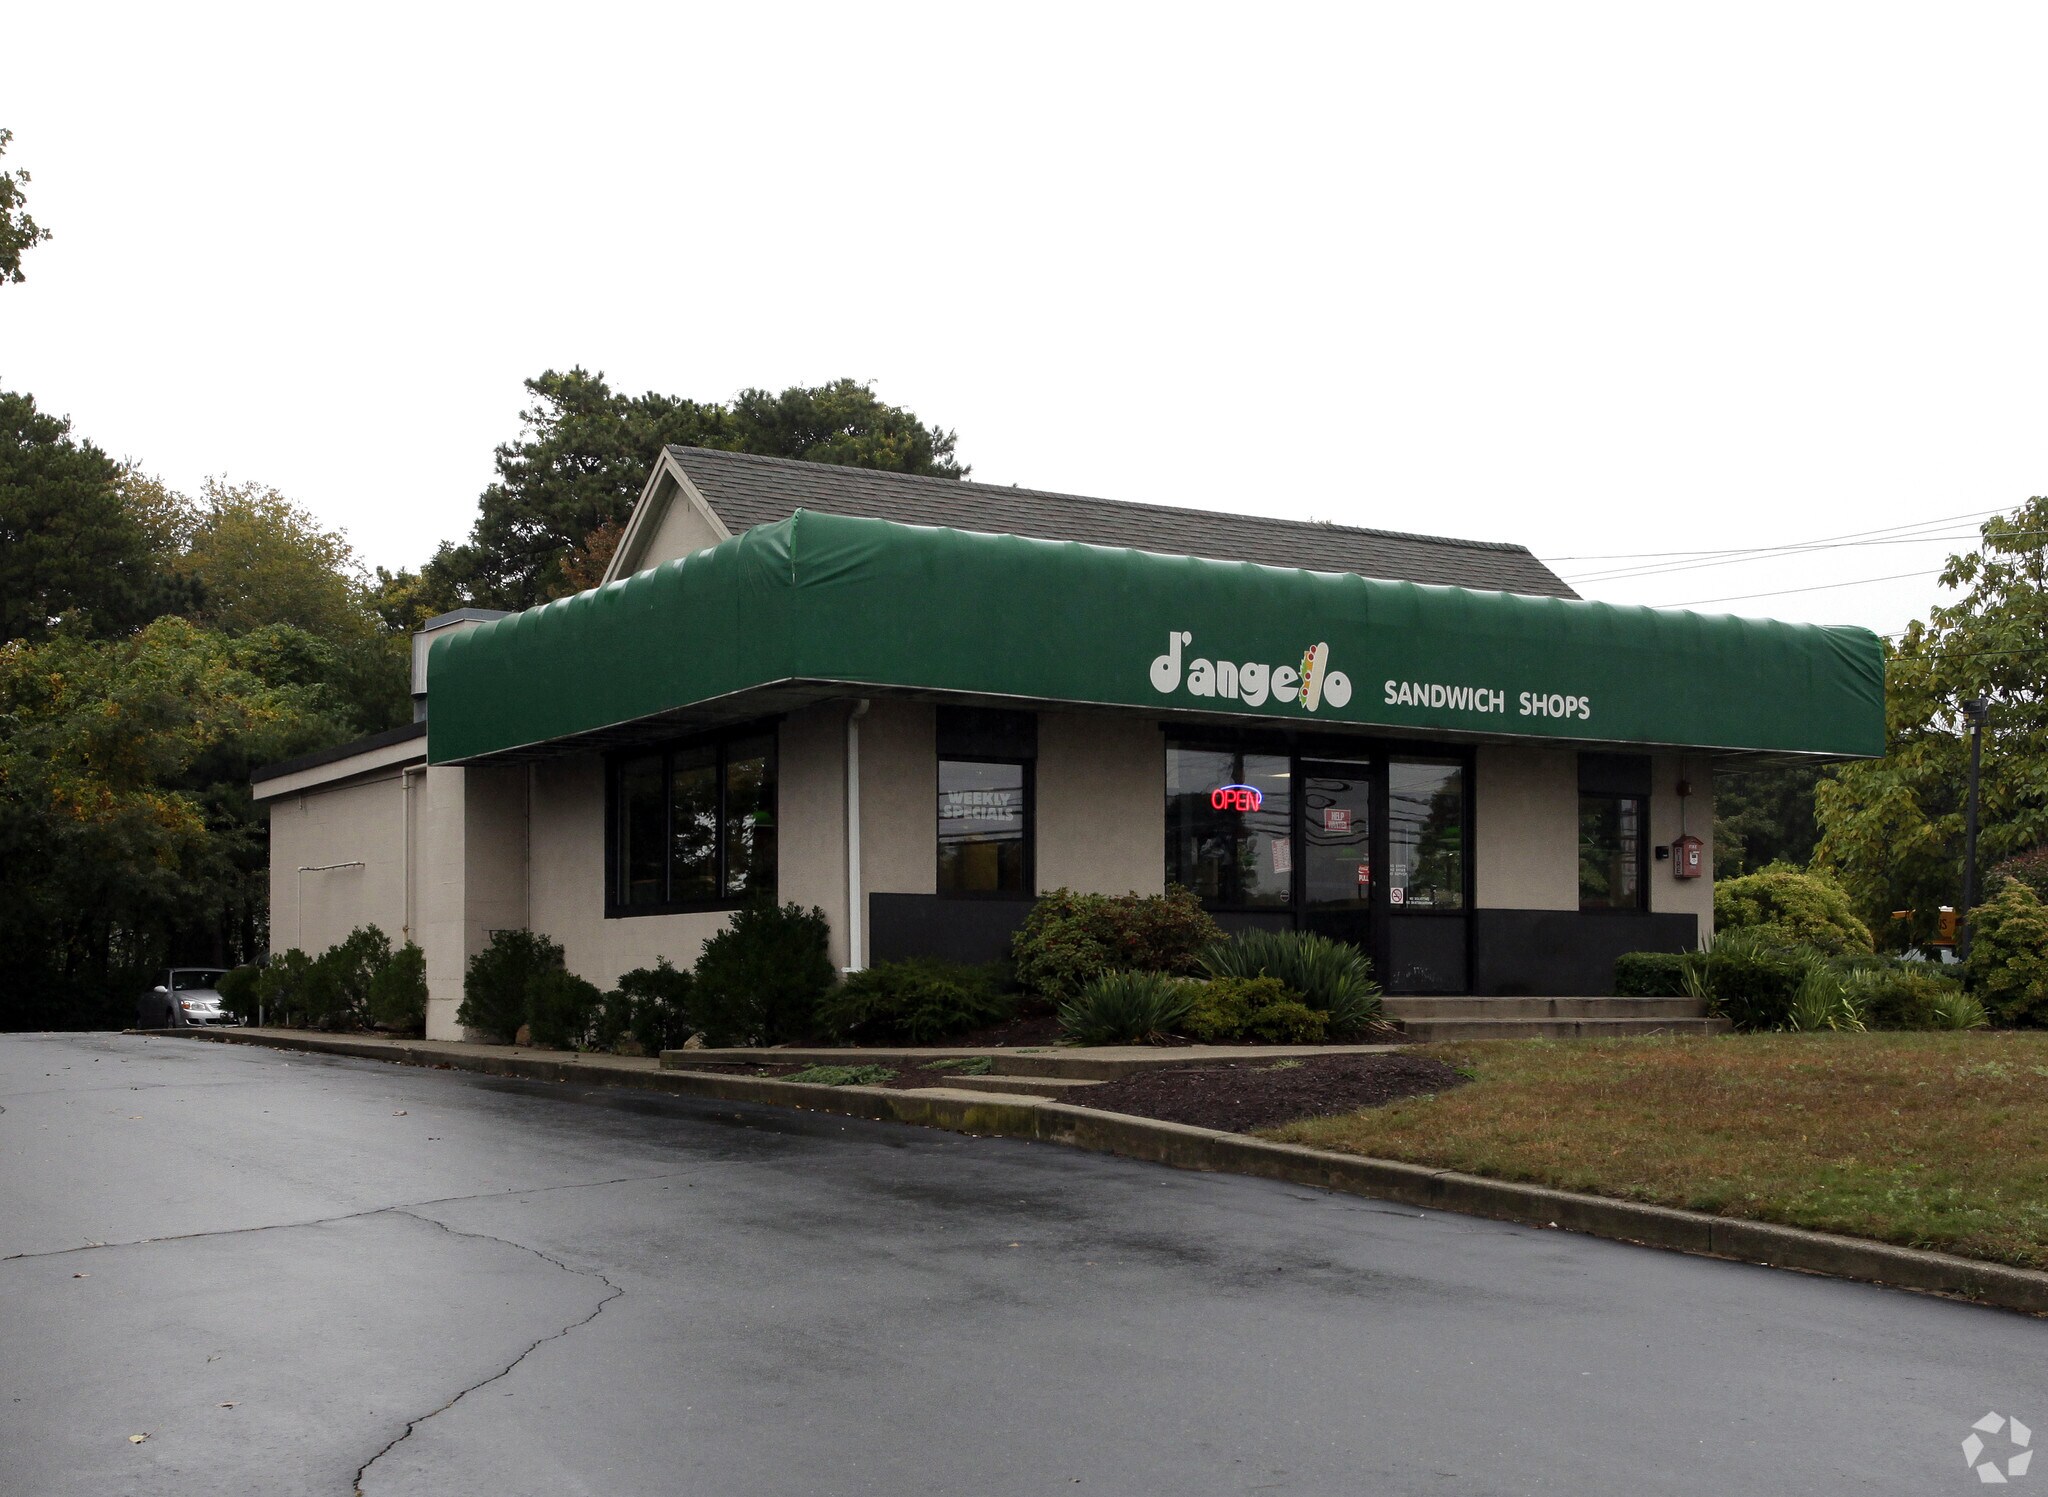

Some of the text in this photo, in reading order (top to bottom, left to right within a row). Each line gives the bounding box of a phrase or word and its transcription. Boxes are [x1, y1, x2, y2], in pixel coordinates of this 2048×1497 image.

[1150, 631, 1352, 712] d'angelo
[1384, 680, 1590, 720] SANDWICH SHOPS
[948, 791, 1010, 805] WEEKLY
[1211, 789, 1259, 811] OPEN
[943, 805, 1013, 821] SPECIALS
[1331, 811, 1345, 821] HELP
